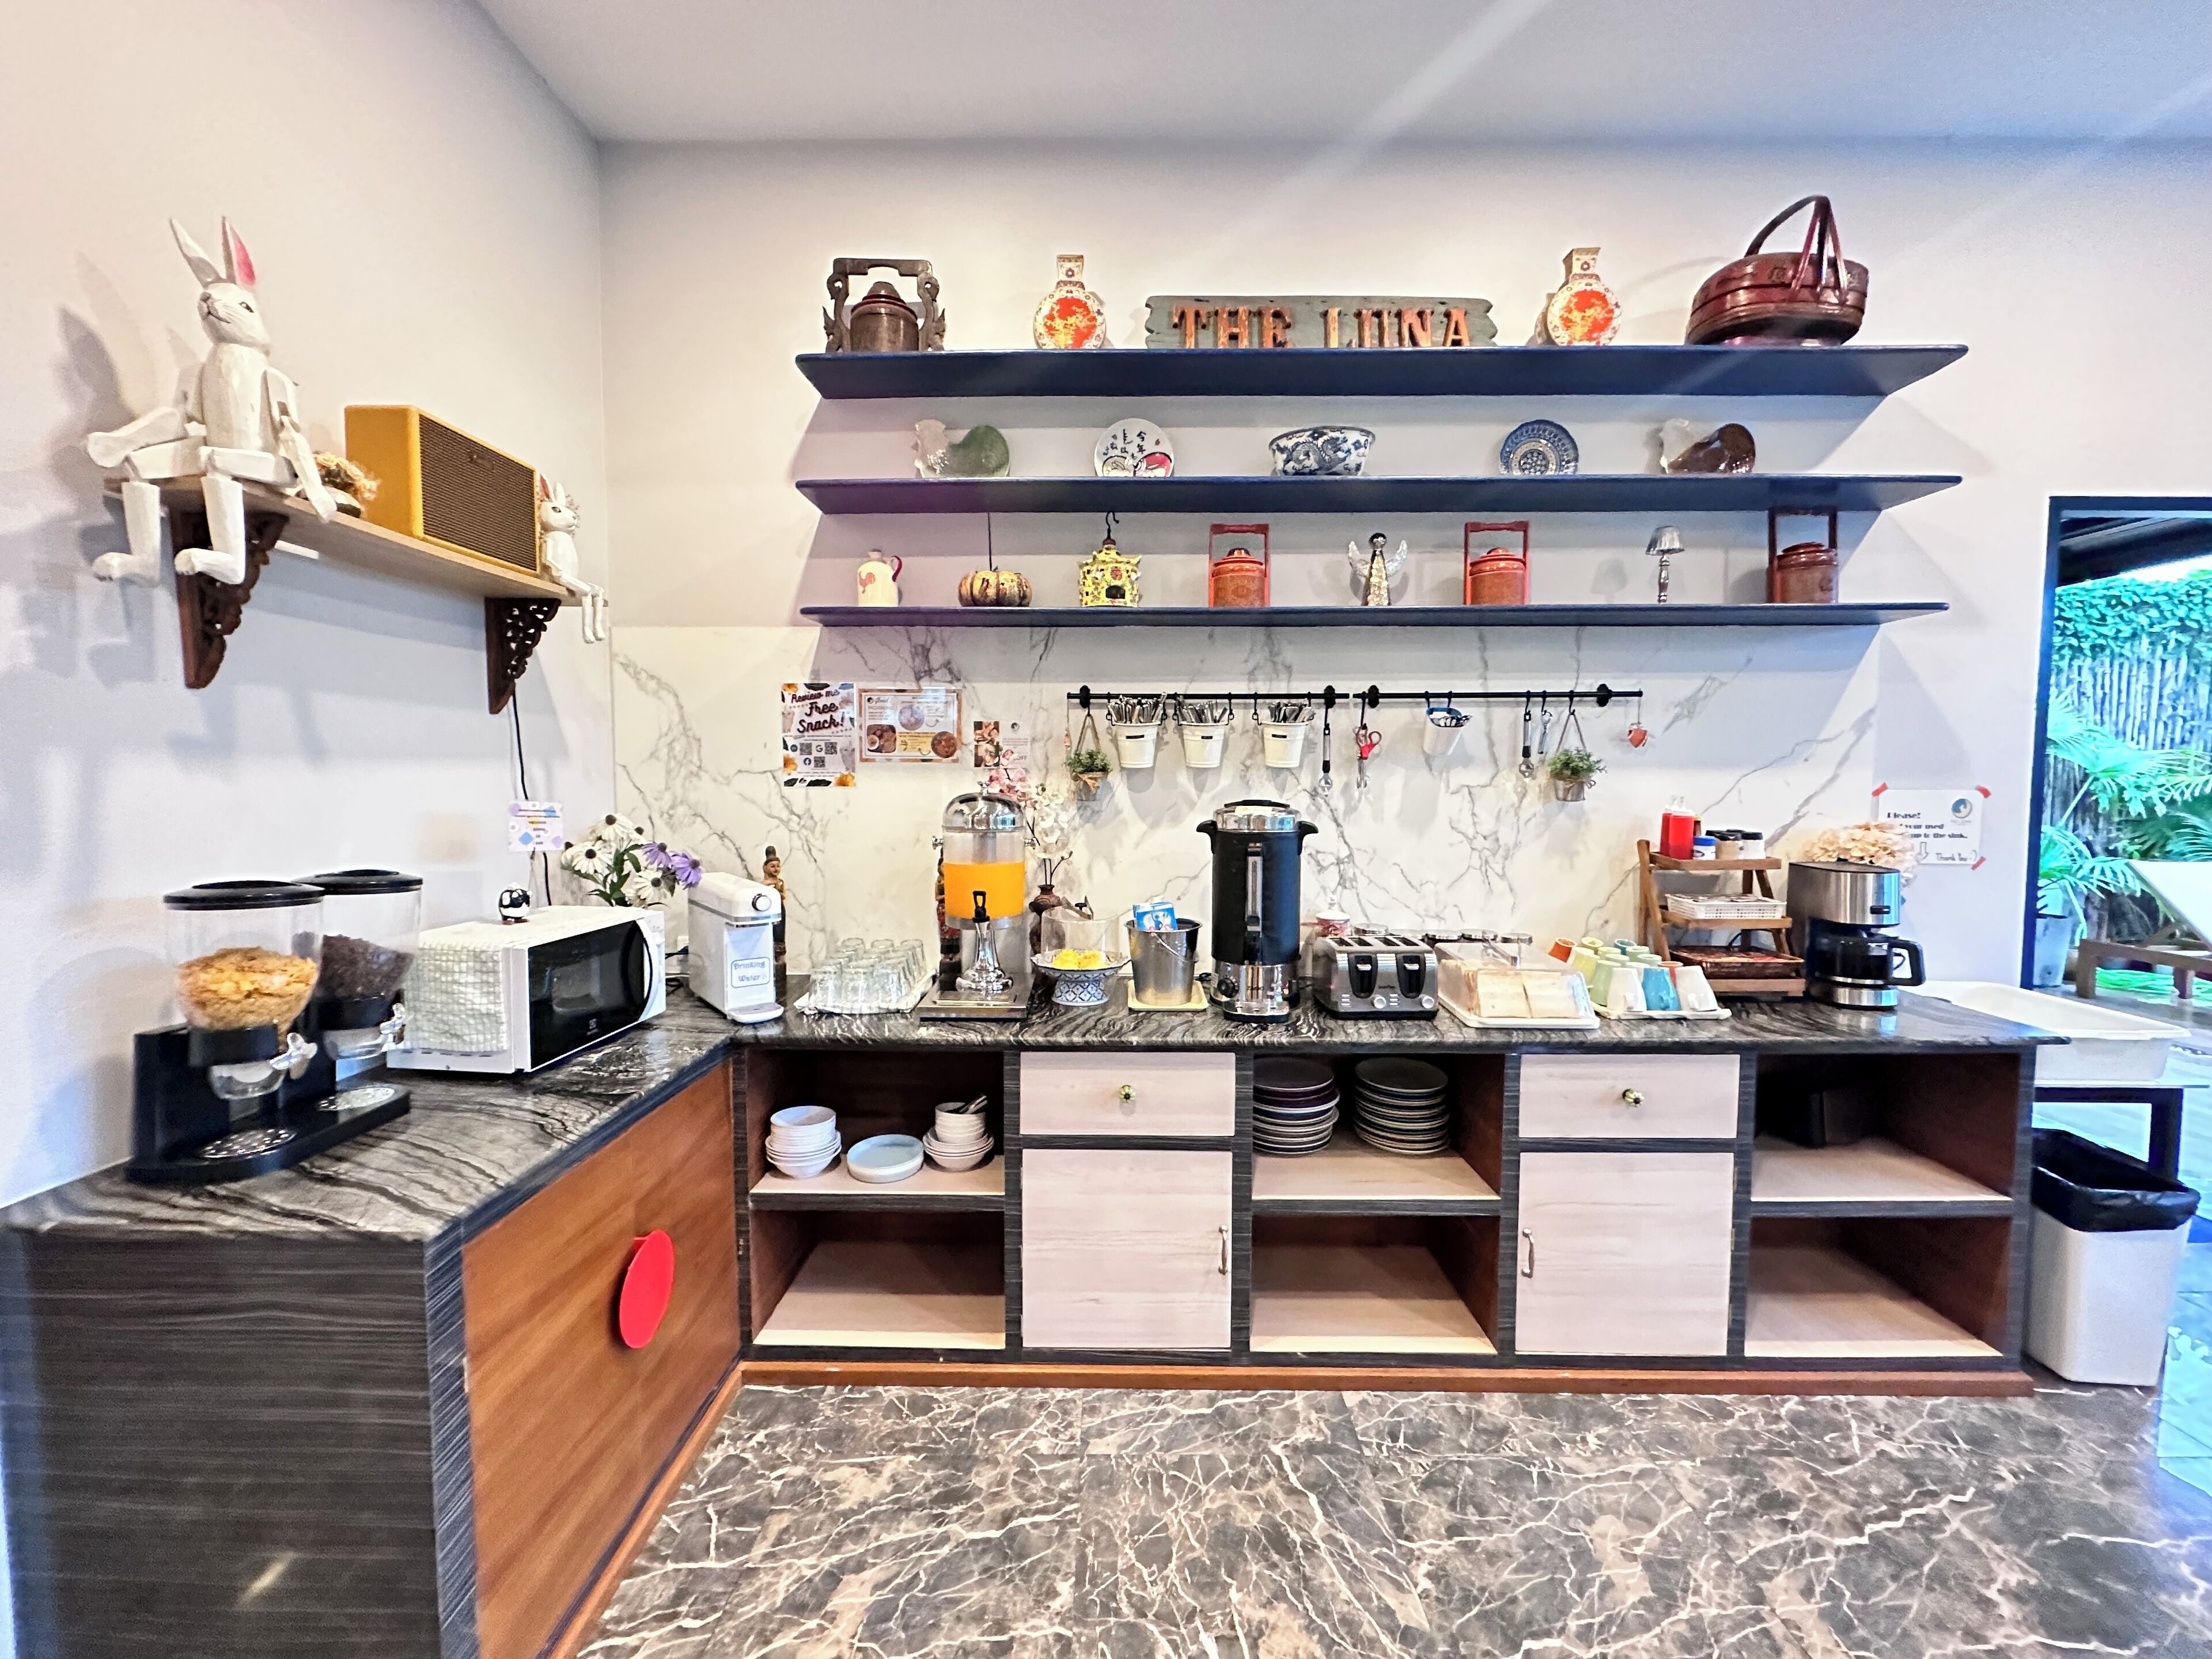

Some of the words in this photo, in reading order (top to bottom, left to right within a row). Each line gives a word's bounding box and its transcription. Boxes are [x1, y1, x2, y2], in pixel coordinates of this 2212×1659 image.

[1172, 305, 1292, 349] THE
[1323, 307, 1471, 347] LUNA
[791, 691, 824, 703] Review
[805, 701, 839, 717] Free
[797, 711, 845, 734] Snack!
[734, 961, 765, 969] Drinking
